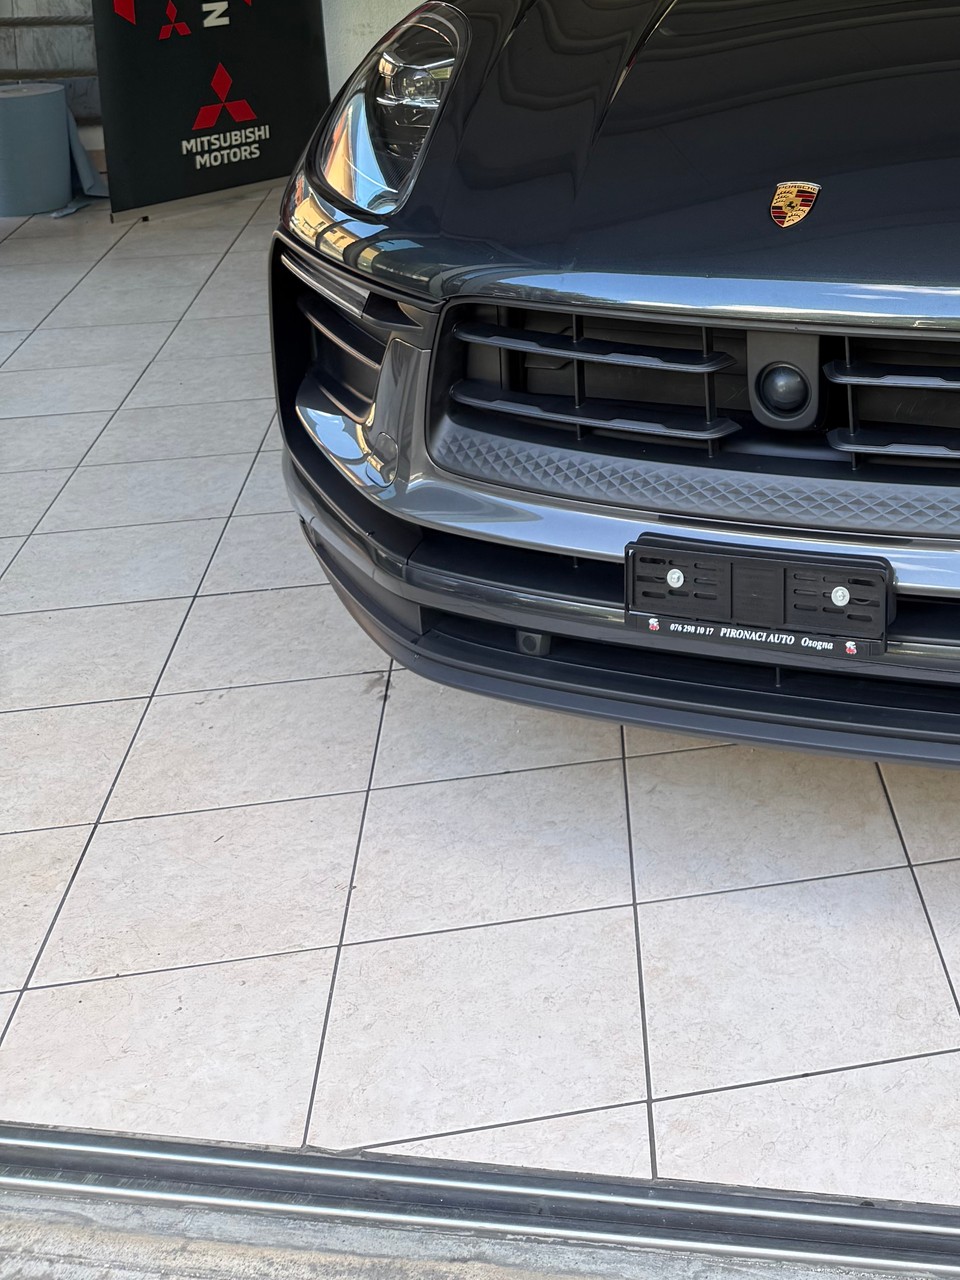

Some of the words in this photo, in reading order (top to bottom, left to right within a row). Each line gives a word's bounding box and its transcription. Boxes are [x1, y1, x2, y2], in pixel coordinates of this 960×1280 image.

[181, 124, 270, 155] MITSUBISHI
[195, 143, 261, 170] MOTORS
[669, 623, 683, 632] 076
[682, 624, 695, 634] 298
[696, 626, 705, 635] 10
[705, 627, 715, 636] 17
[720, 627, 767, 642] PIRONACI
[766, 632, 795, 645] AUTO
